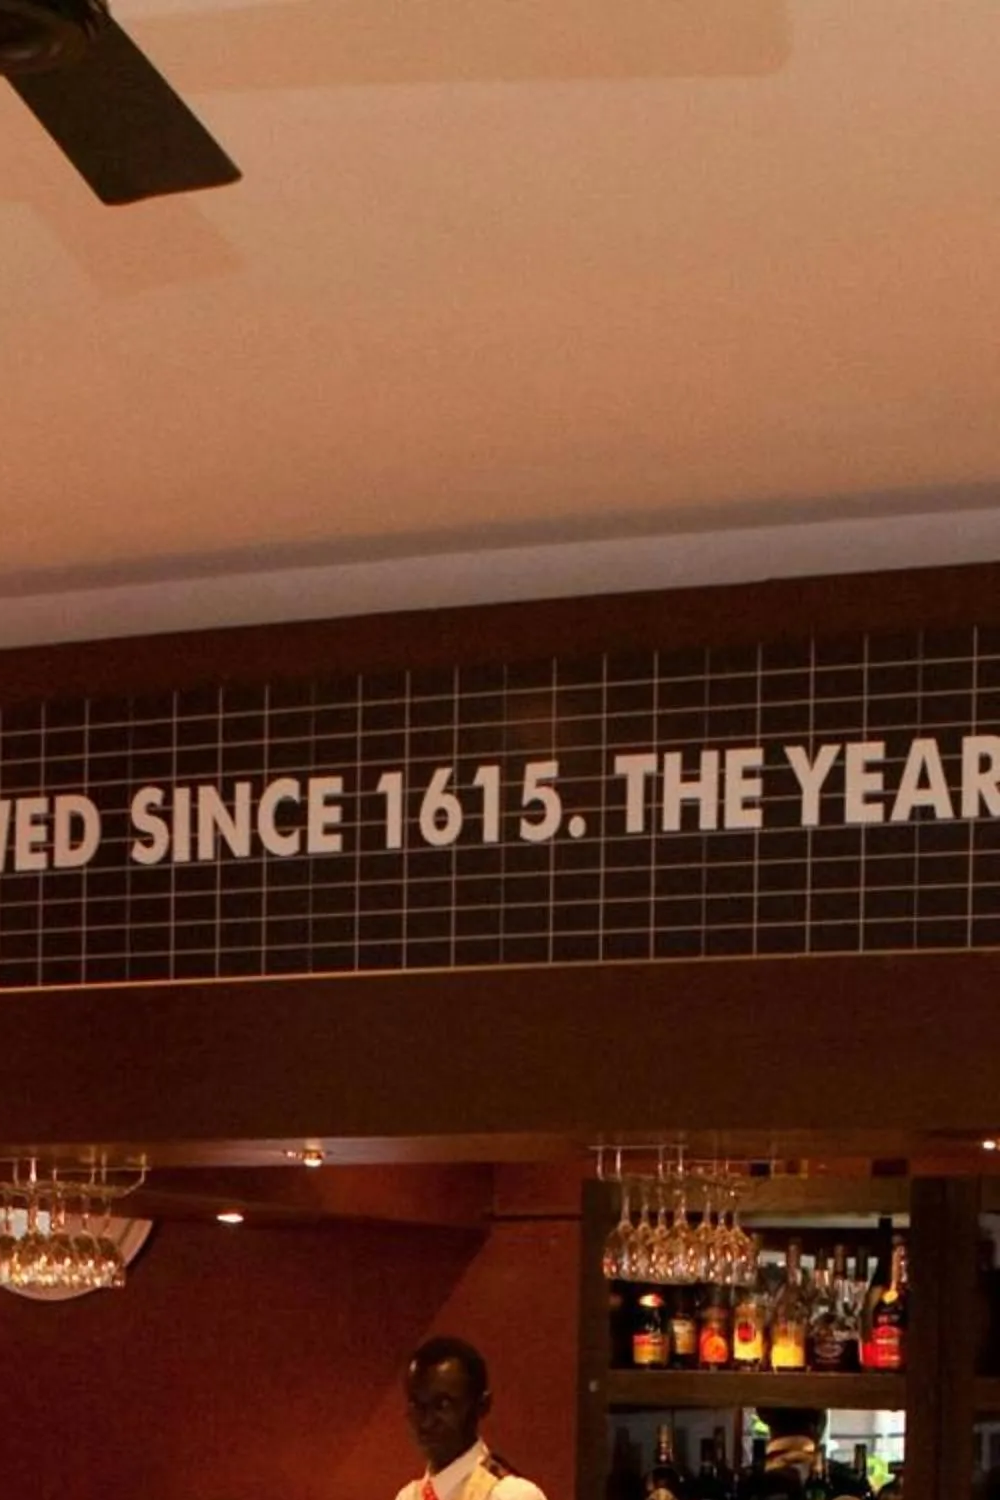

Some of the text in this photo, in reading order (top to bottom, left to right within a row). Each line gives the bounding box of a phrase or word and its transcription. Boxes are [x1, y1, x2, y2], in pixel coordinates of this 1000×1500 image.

[130, 776, 344, 865] SINCE
[376, 761, 587, 849] 1615.
[615, 747, 764, 834] THE
[784, 734, 1000, 827] YEAR
